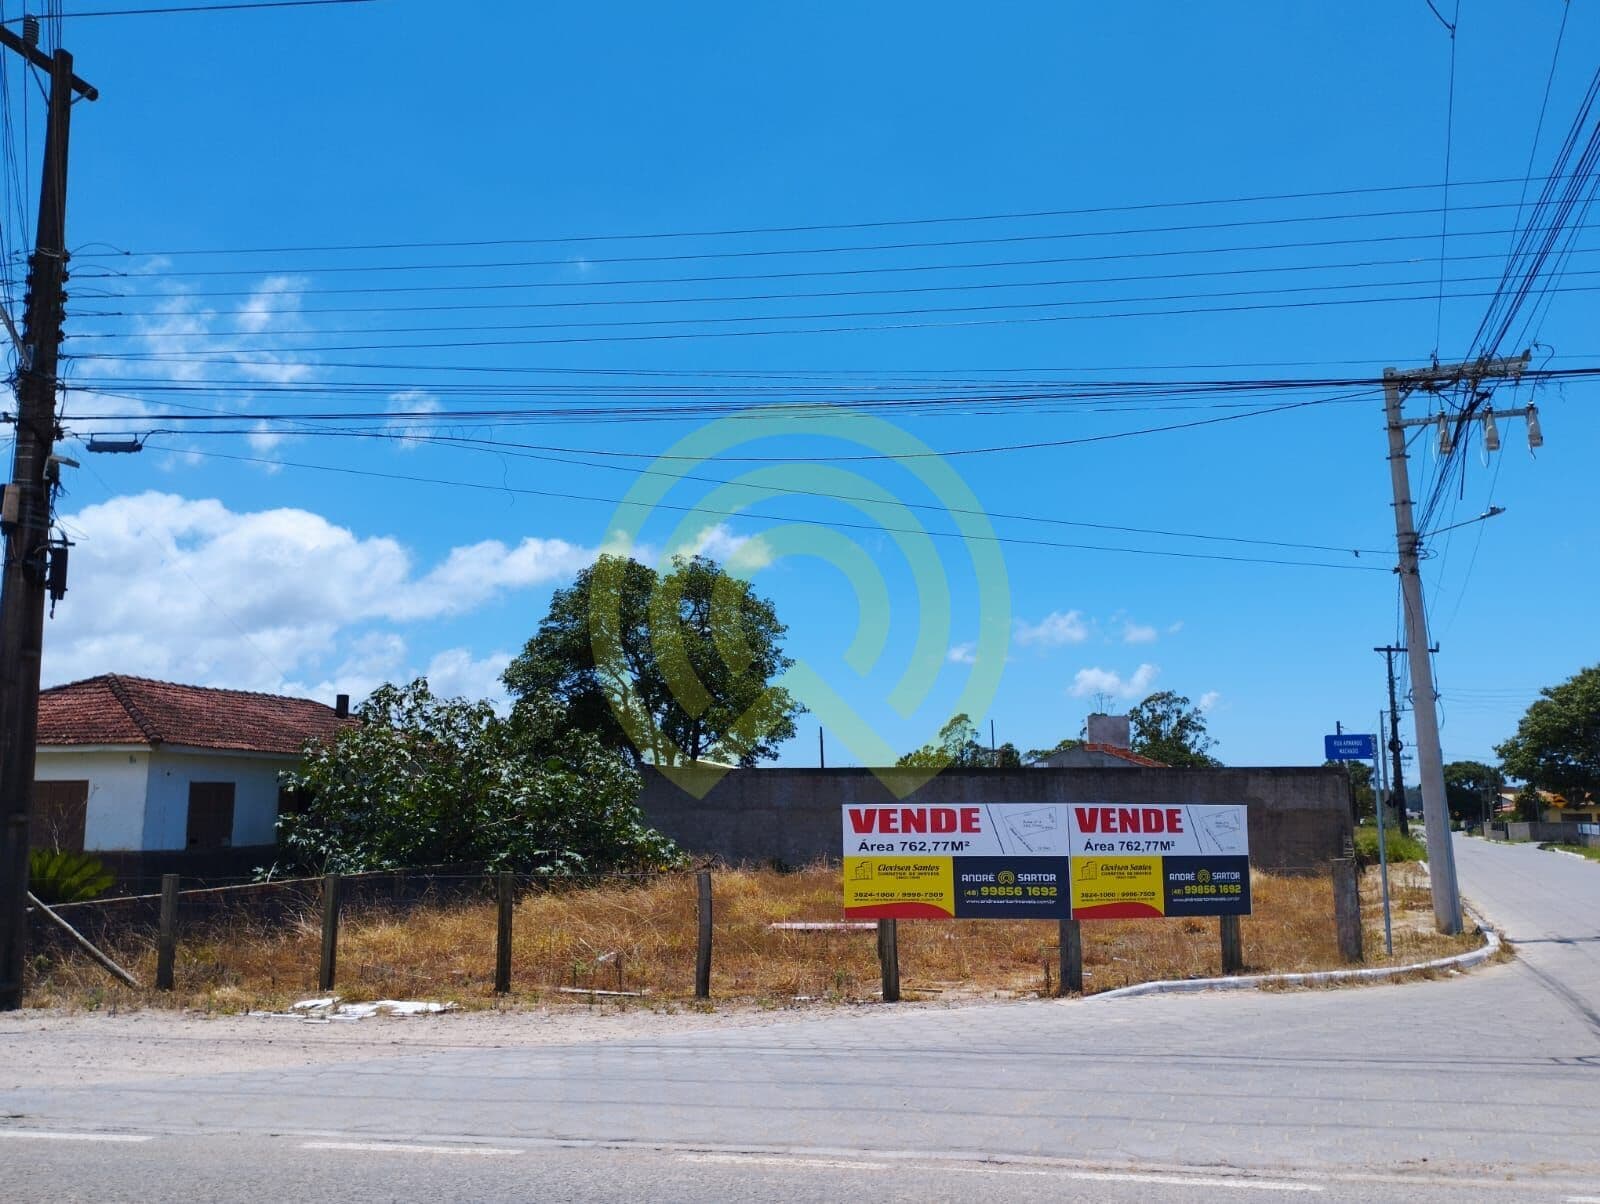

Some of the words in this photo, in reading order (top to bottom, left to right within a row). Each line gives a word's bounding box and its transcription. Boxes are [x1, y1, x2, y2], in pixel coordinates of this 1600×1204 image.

[848, 808, 982, 834] VENDE
[1074, 807, 1184, 834] VENDE
[858, 839, 895, 852] Área
[899, 841, 970, 853] 762,77M²
[1084, 839, 1115, 852] Área
[1118, 840, 1176, 853] 762,77M²
[912, 863, 941, 872] Santos
[961, 873, 996, 882] ANDRÉ
[1017, 873, 1057, 882] SARTOR
[1169, 872, 1196, 881] ANDRÉ
[1211, 871, 1241, 880] SARTOR
[1026, 886, 1058, 896] 1692
[1218, 884, 1242, 894] 1692
